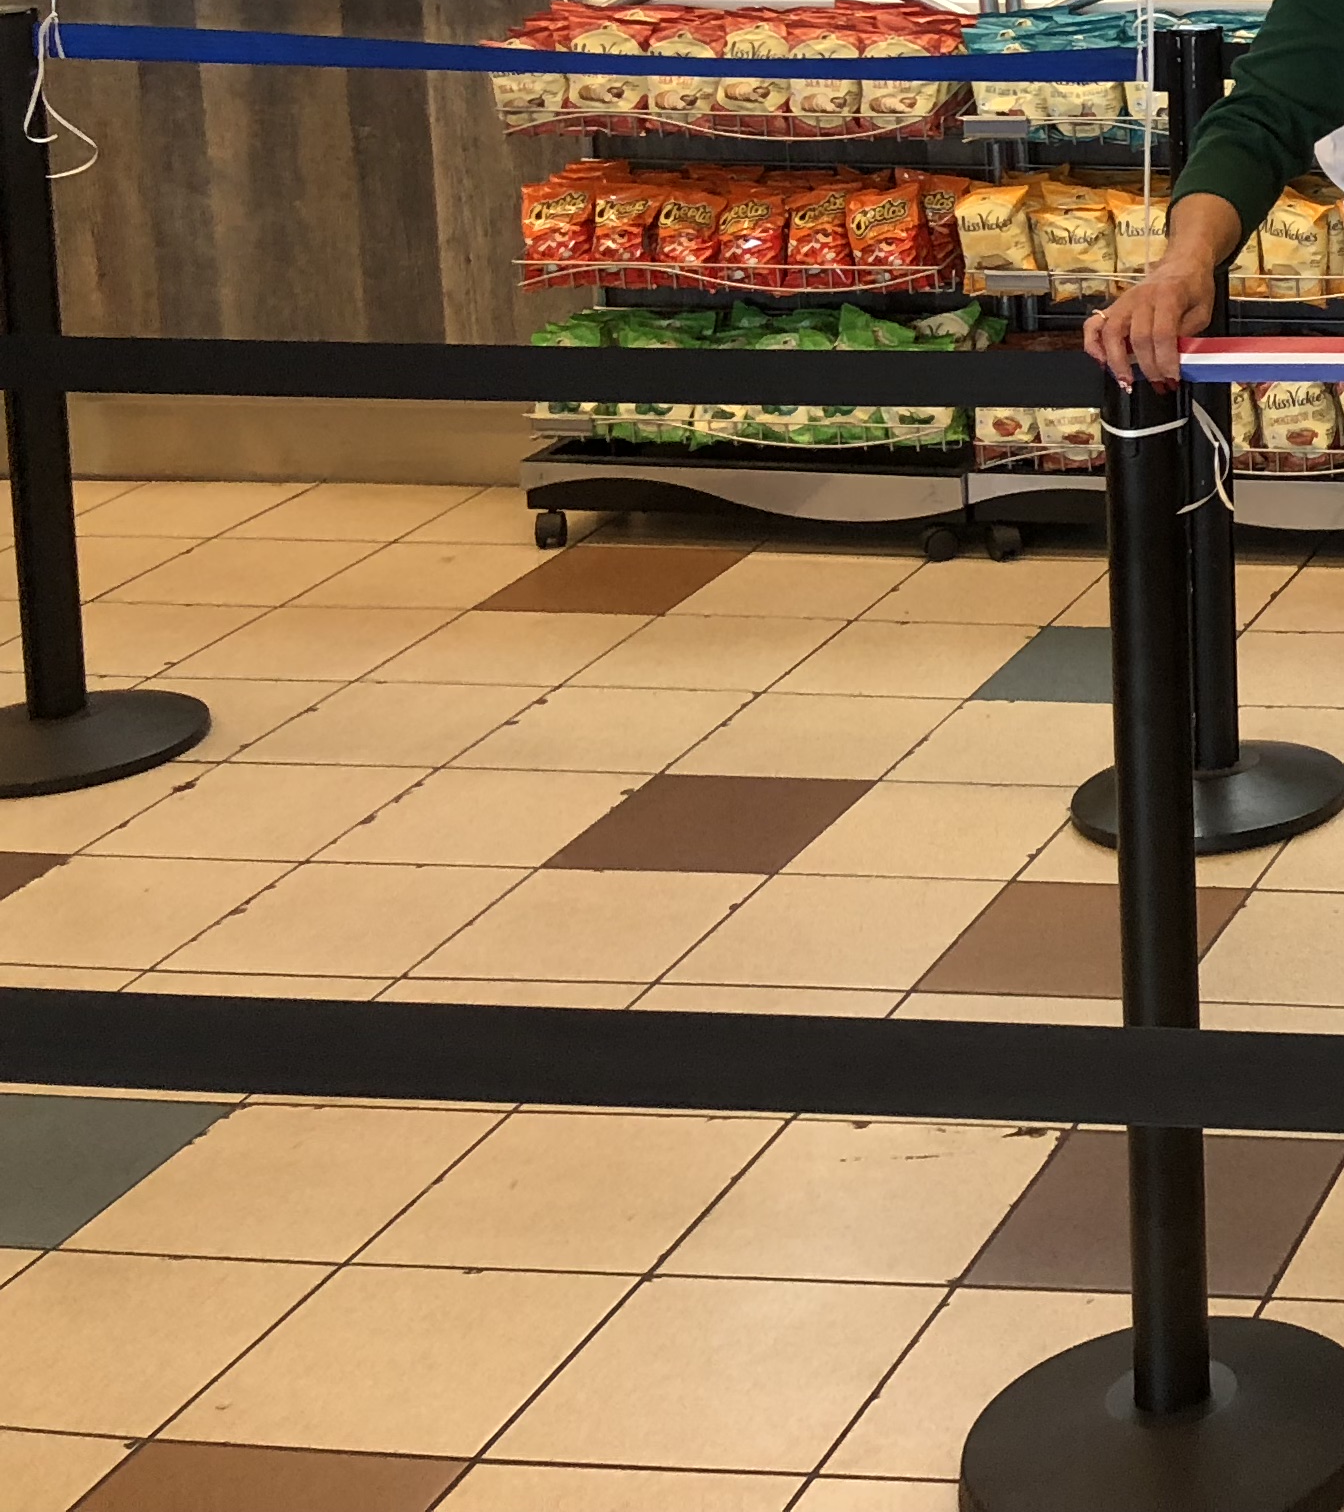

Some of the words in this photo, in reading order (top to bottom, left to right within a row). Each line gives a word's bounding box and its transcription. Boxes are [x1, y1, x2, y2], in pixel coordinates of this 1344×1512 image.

[528, 191, 588, 225] Cheetos
[851, 199, 909, 237] Cheetos
[1282, 220, 1318, 243] Vickie's
[1264, 392, 1291, 411] Miss
